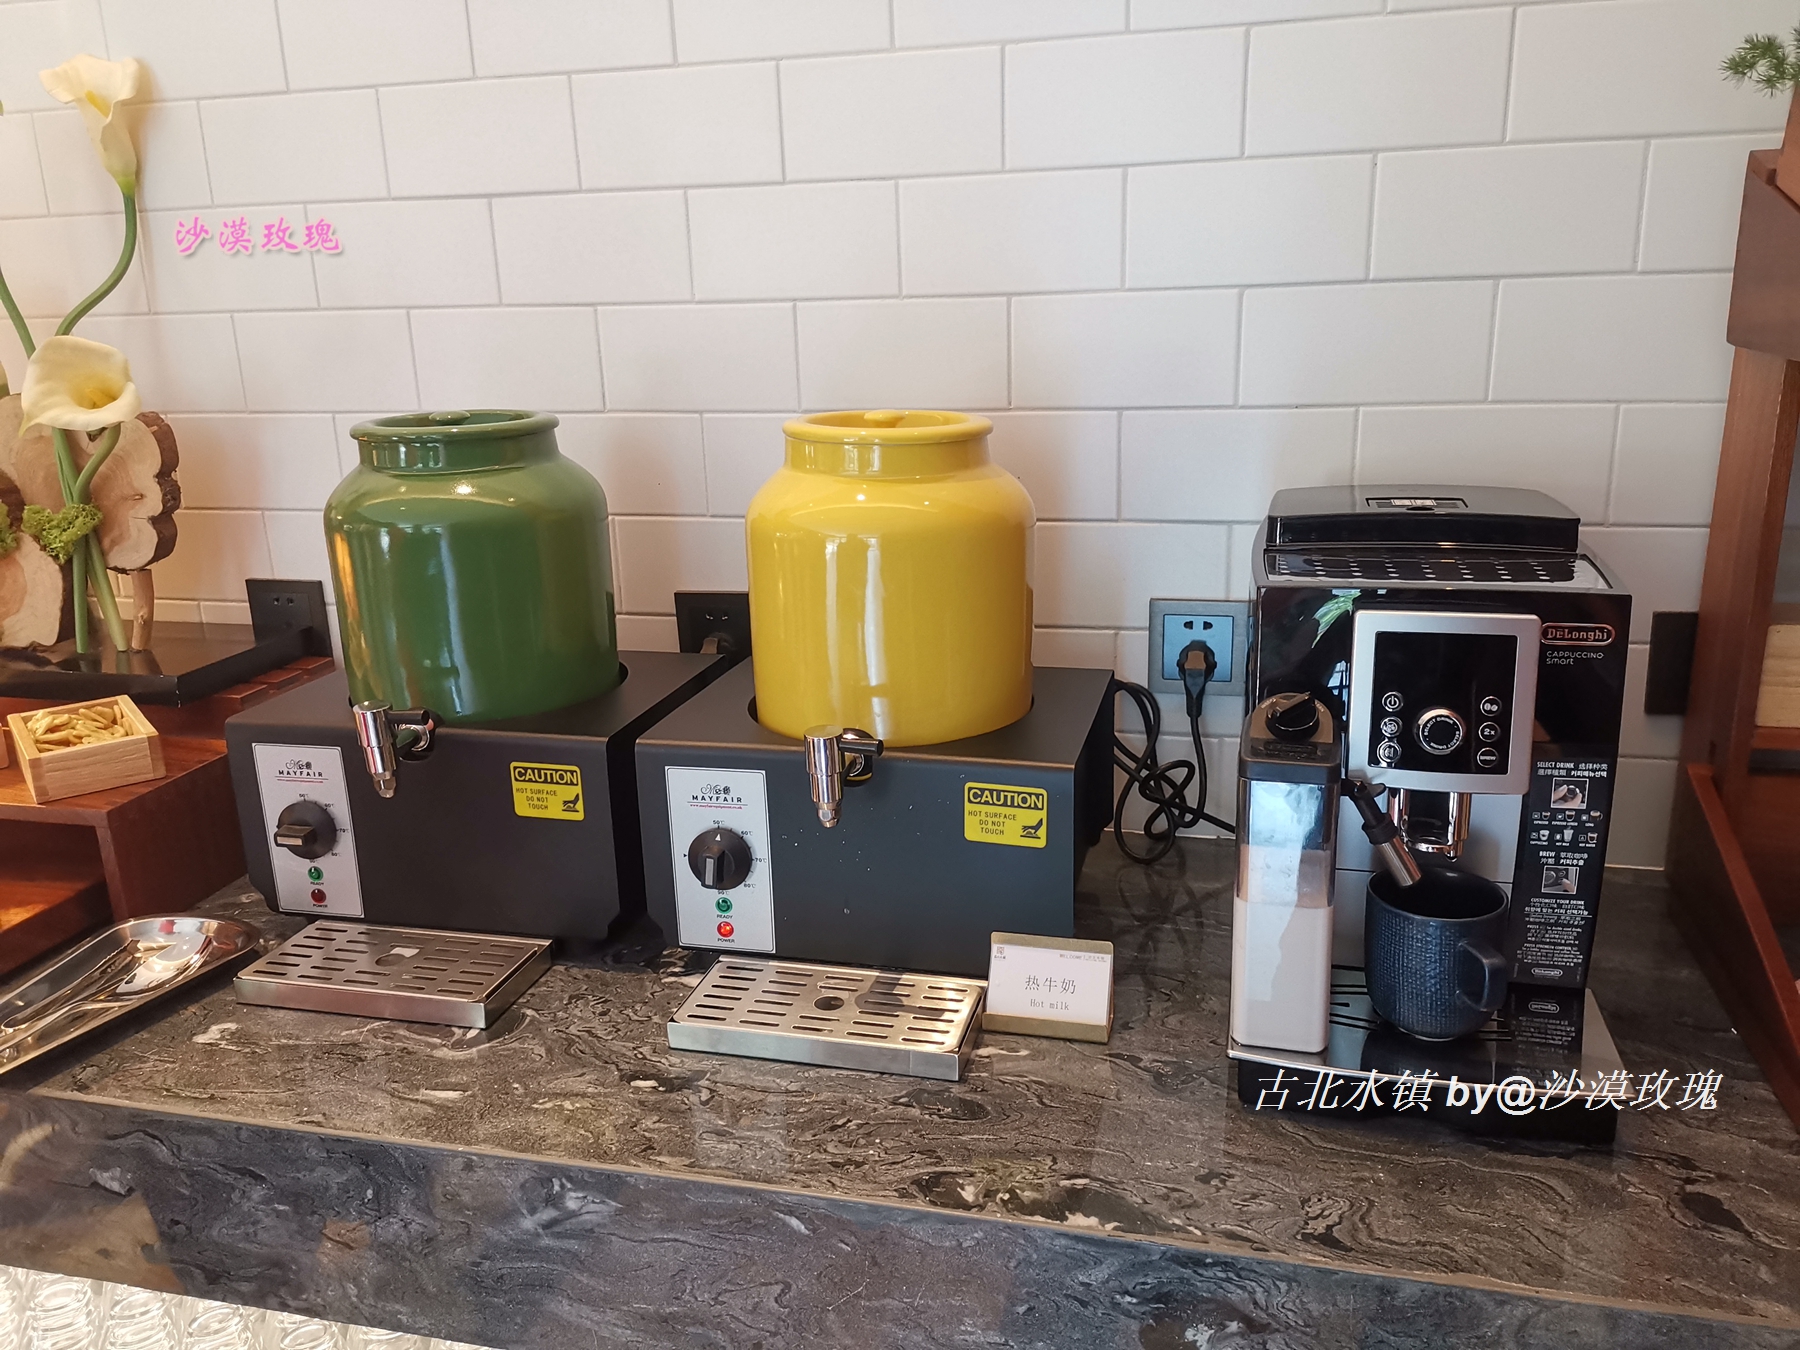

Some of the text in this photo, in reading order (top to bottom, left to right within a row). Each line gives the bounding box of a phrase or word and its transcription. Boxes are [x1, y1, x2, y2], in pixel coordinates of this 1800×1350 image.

[1546, 651, 1604, 659] CAPPUCCINO
[514, 768, 578, 784] CAUTION
[530, 788, 558, 796] SURFACE
[692, 794, 742, 803] MAYFAIR
[969, 788, 1042, 809] CAUTION
[984, 812, 1017, 820] SURFACE
[980, 827, 1004, 835] TOUCH
[1024, 974, 1076, 995] 热牛奶
[1030, 998, 1070, 1010] Hot milk
